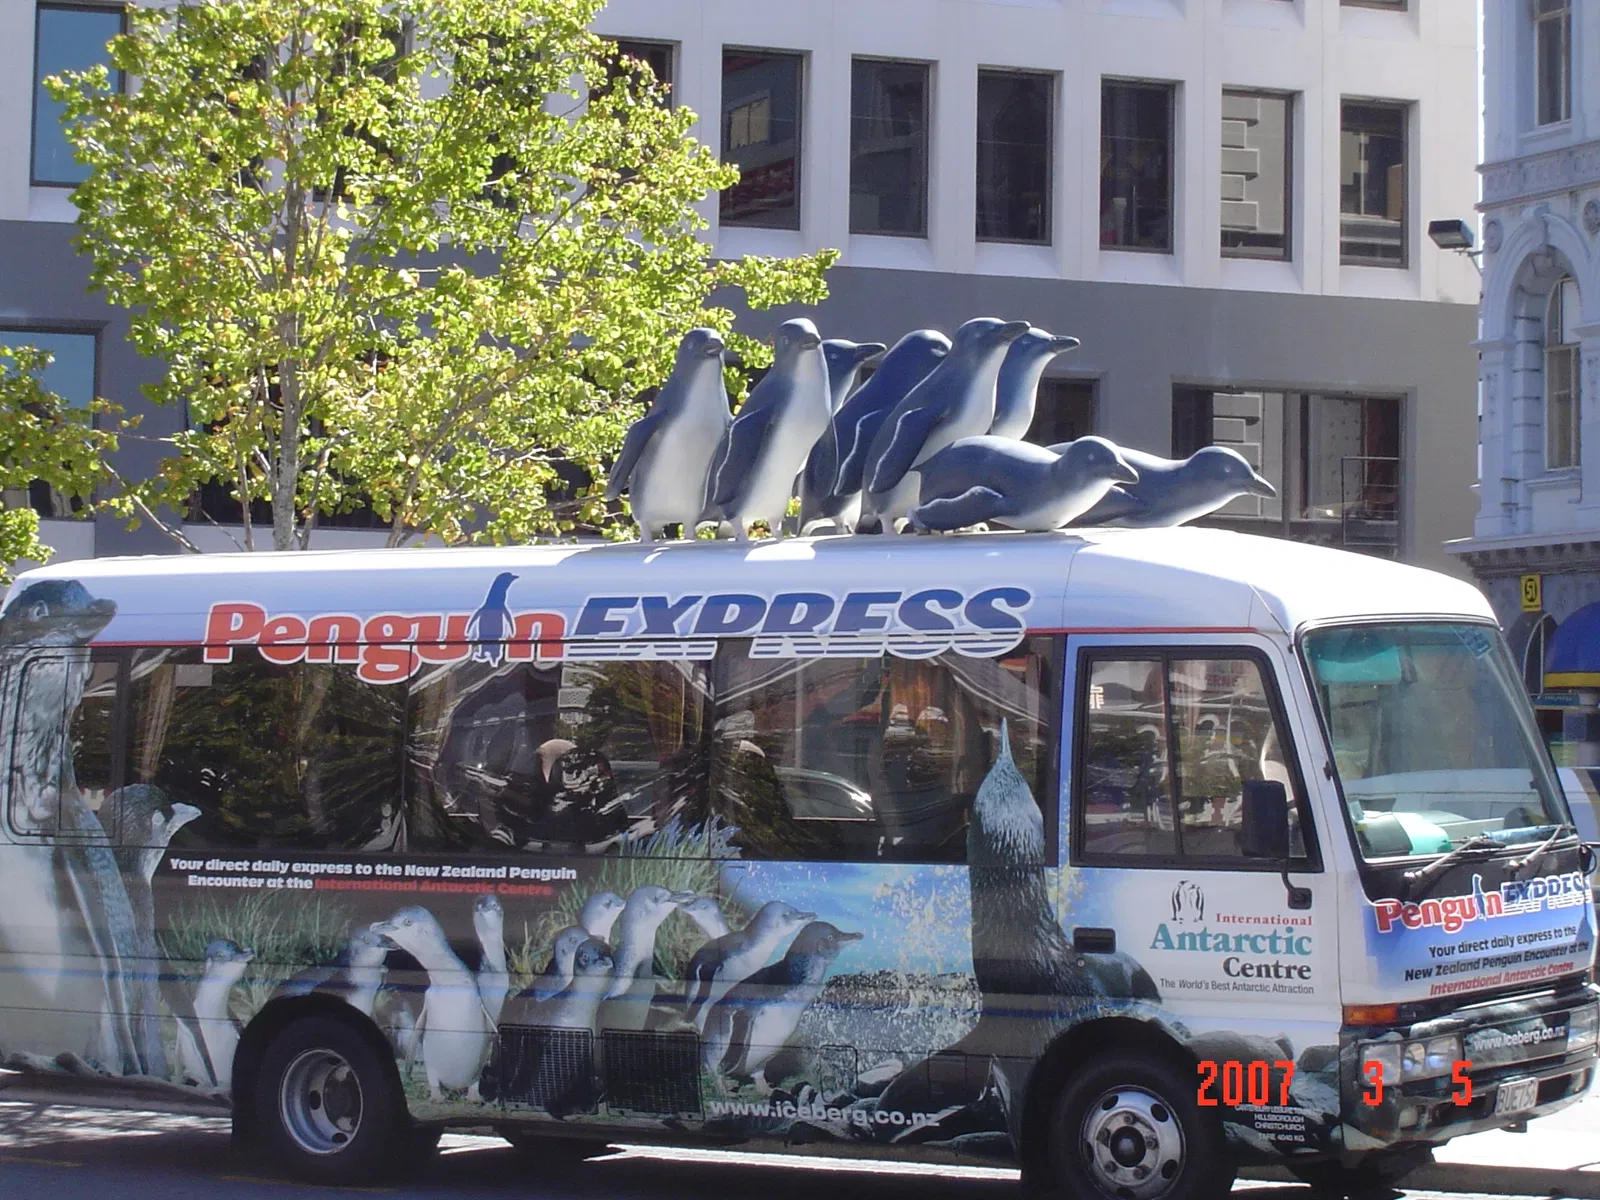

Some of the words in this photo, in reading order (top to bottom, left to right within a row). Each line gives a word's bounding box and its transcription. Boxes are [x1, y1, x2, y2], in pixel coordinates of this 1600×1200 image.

[203, 573, 566, 684] Penguin
[564, 586, 1035, 660] EXPRESS
[170, 858, 203, 871] Your
[205, 859, 250, 872] direct
[252, 860, 290, 875] daily
[291, 863, 352, 875] express
[355, 864, 372, 875] to
[375, 863, 403, 876] the
[405, 865, 439, 877] New
[441, 866, 507, 879] Zealand
[509, 866, 577, 881] Penguin
[188, 875, 265, 888] Encounter
[266, 877, 284, 889] at
[286, 877, 313, 889] the
[315, 879, 417, 893] International
[420, 881, 494, 894] Antarctic
[498, 882, 552, 896] Centre
[1374, 874, 1503, 933] Penguin
[1216, 913, 1312, 926] International
[1149, 923, 1312, 956] Antarctic
[1429, 944, 1456, 959] Your
[1458, 940, 1489, 954] direct
[1491, 935, 1515, 949] daily
[1516, 931, 1552, 946] express
[1553, 928, 1564, 938] to
[1565, 926, 1577, 937] the
[1222, 956, 1312, 980] Centre
[1405, 966, 1433, 982] New
[1435, 958, 1481, 977] Zealand
[1482, 952, 1522, 969] Penguin
[1524, 945, 1568, 962] Encounter
[1569, 942, 1578, 954] at
[1578, 940, 1590, 952] the
[1160, 978, 1176, 989] The
[1178, 979, 1209, 991] World's
[1211, 980, 1230, 991] Best
[1231, 981, 1271, 993] Antarctic
[1272, 983, 1315, 995] Attraction
[1430, 974, 1502, 996] International
[1503, 965, 1547, 984] Antarctic
[1547, 960, 1574, 976] Centre
[1473, 1026, 1566, 1051] www.iceberg.co.nz
[709, 1100, 941, 1127] www.iceberg.co.nz
[1254, 1113, 1304, 1122] HILLSBOROUGH
[1255, 1122, 1305, 1131] CHRISTCHURCH
